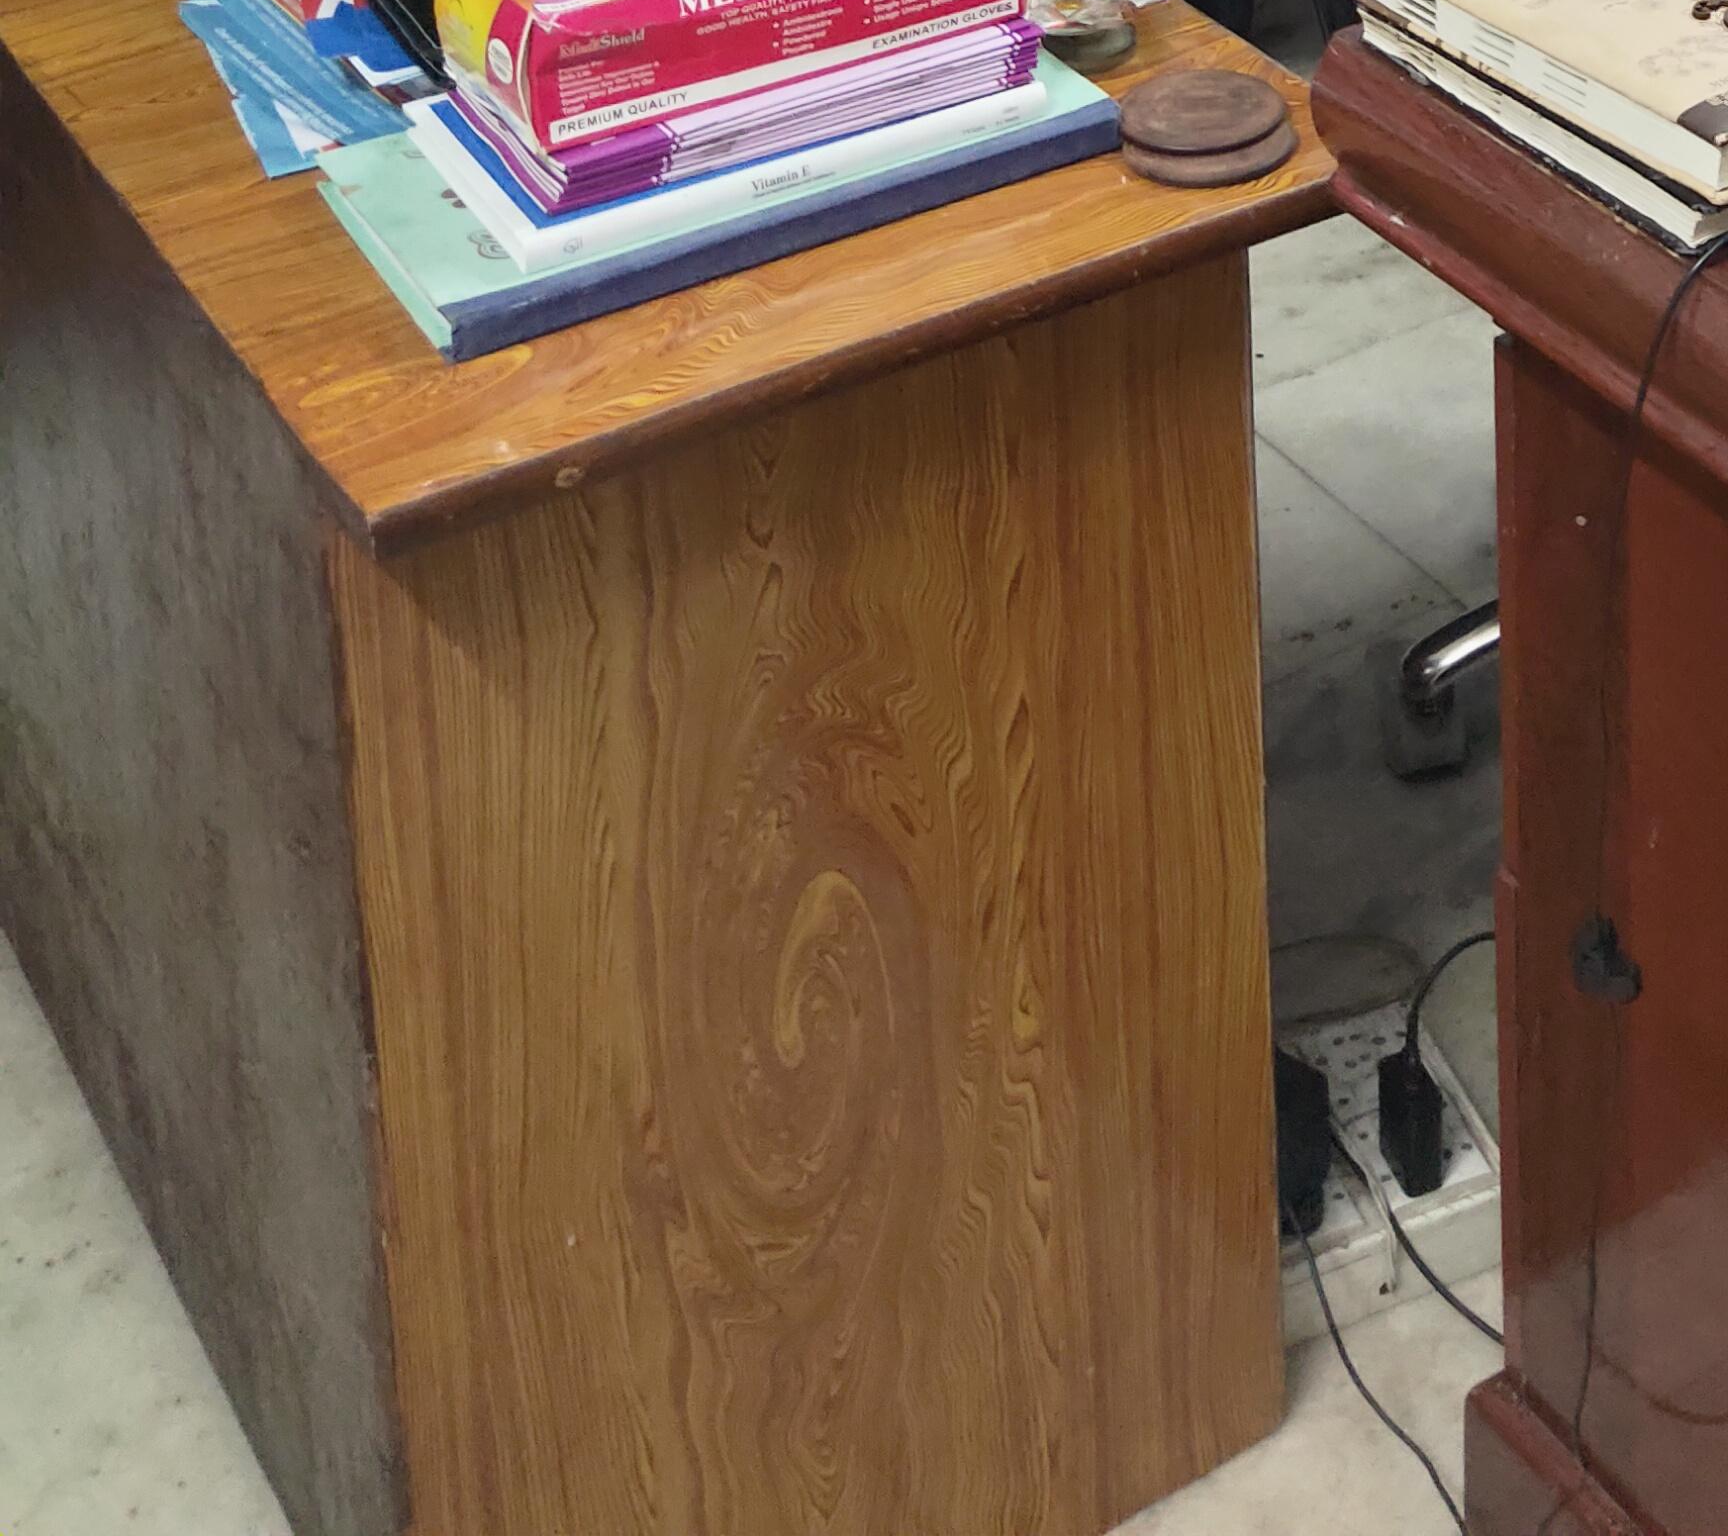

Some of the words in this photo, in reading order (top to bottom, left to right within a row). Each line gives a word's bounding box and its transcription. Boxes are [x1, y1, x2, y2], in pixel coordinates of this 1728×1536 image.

[772, 0, 811, 16] SAFETY
[872, 15, 959, 49] EXAMINATION
[962, 1, 1014, 24] GLOVES
[558, 104, 625, 137] PREMIUM
[627, 91, 689, 116] QUALITY
[751, 168, 799, 192] Vitamin
[801, 164, 812, 178] E
